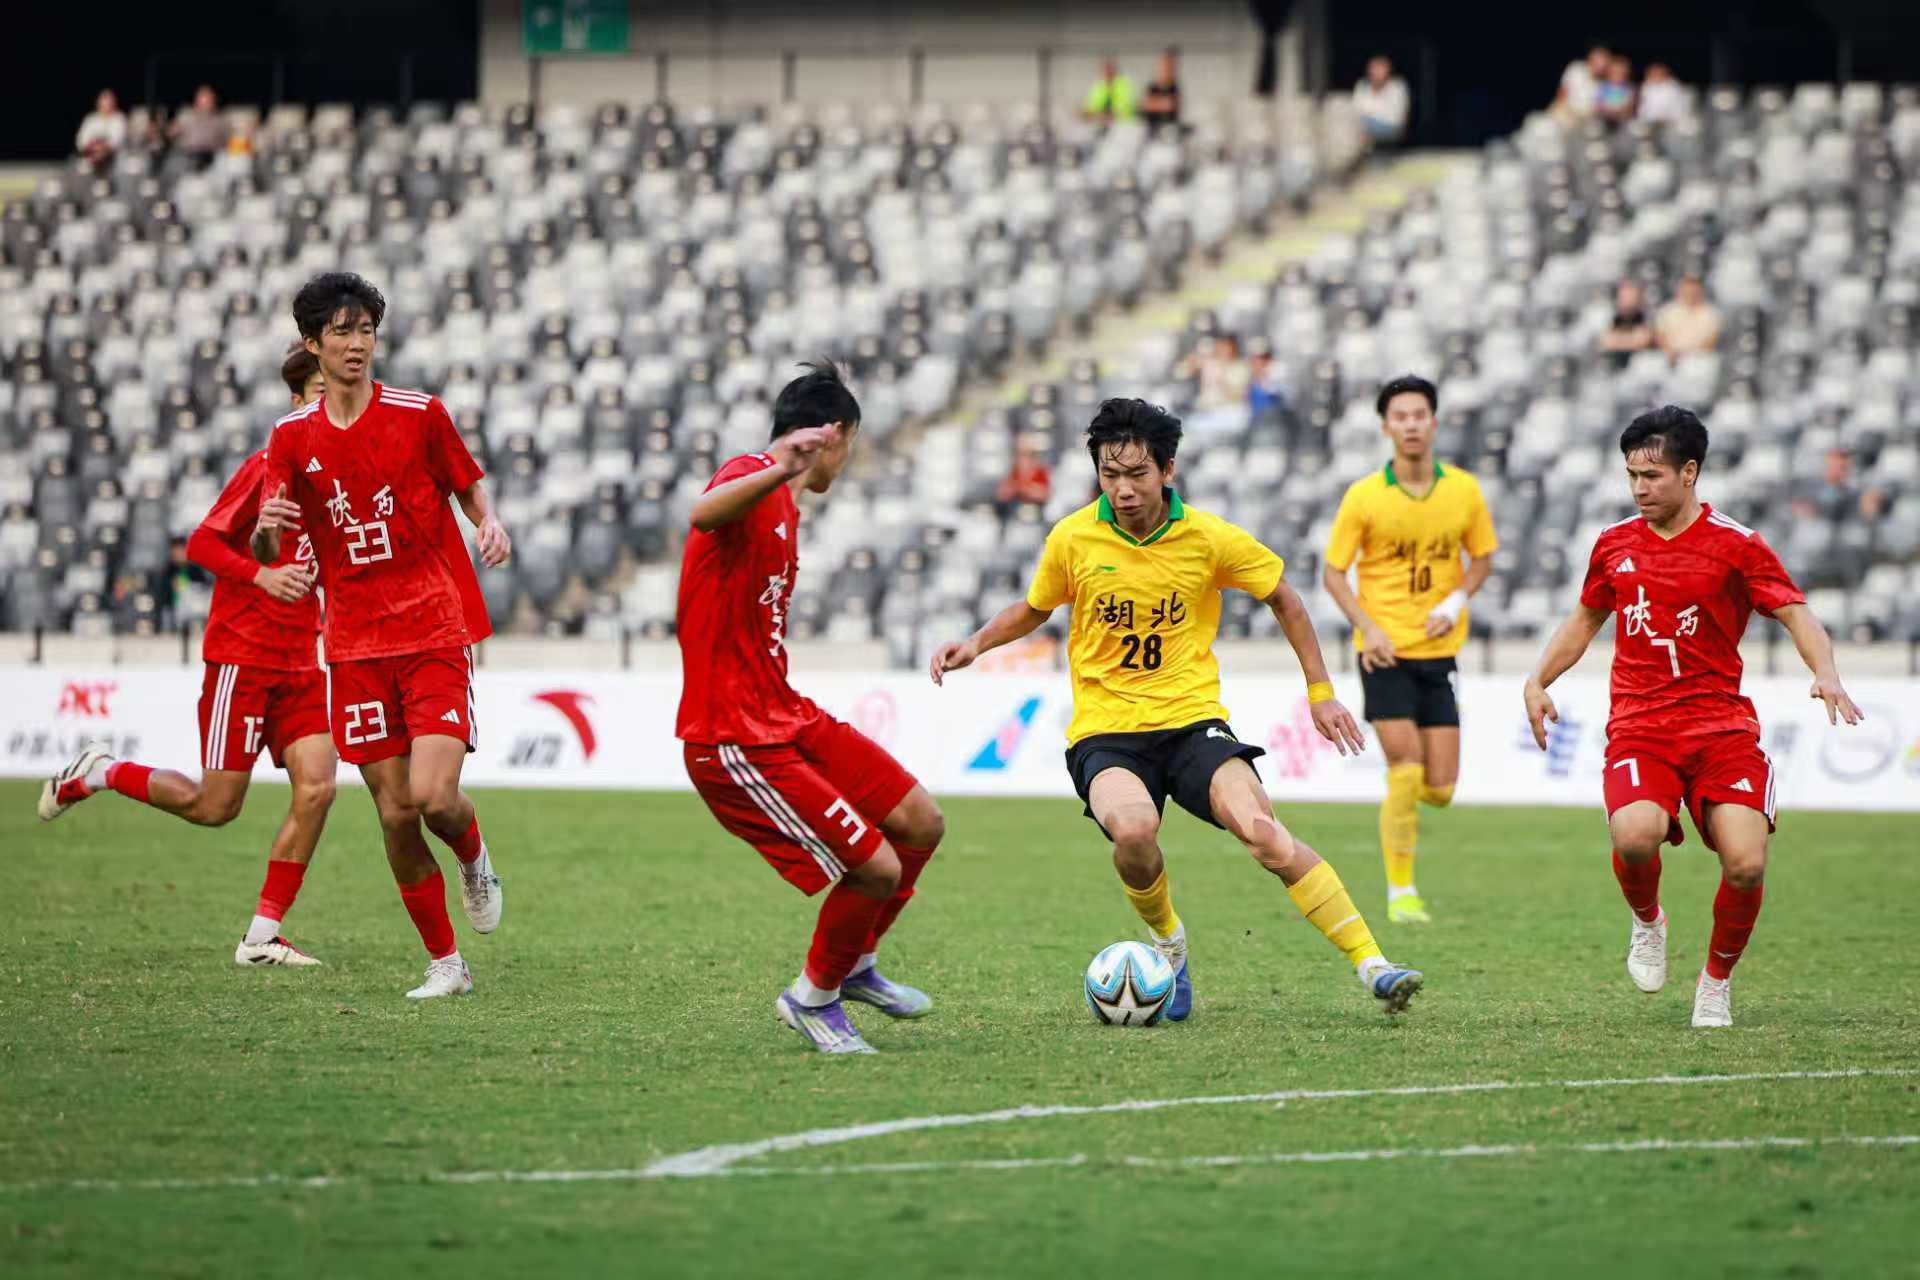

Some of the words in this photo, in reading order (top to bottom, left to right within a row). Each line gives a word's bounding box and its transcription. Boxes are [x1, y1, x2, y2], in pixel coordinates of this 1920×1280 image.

[344, 521, 393, 565] 23
[1409, 565, 1431, 594] 10
[1096, 591, 1187, 630] 湖北
[1120, 634, 1162, 671] 28
[1651, 639, 1681, 677] 7
[345, 700, 388, 745] 23
[1613, 757, 1641, 787] 7
[824, 797, 868, 846] 3
